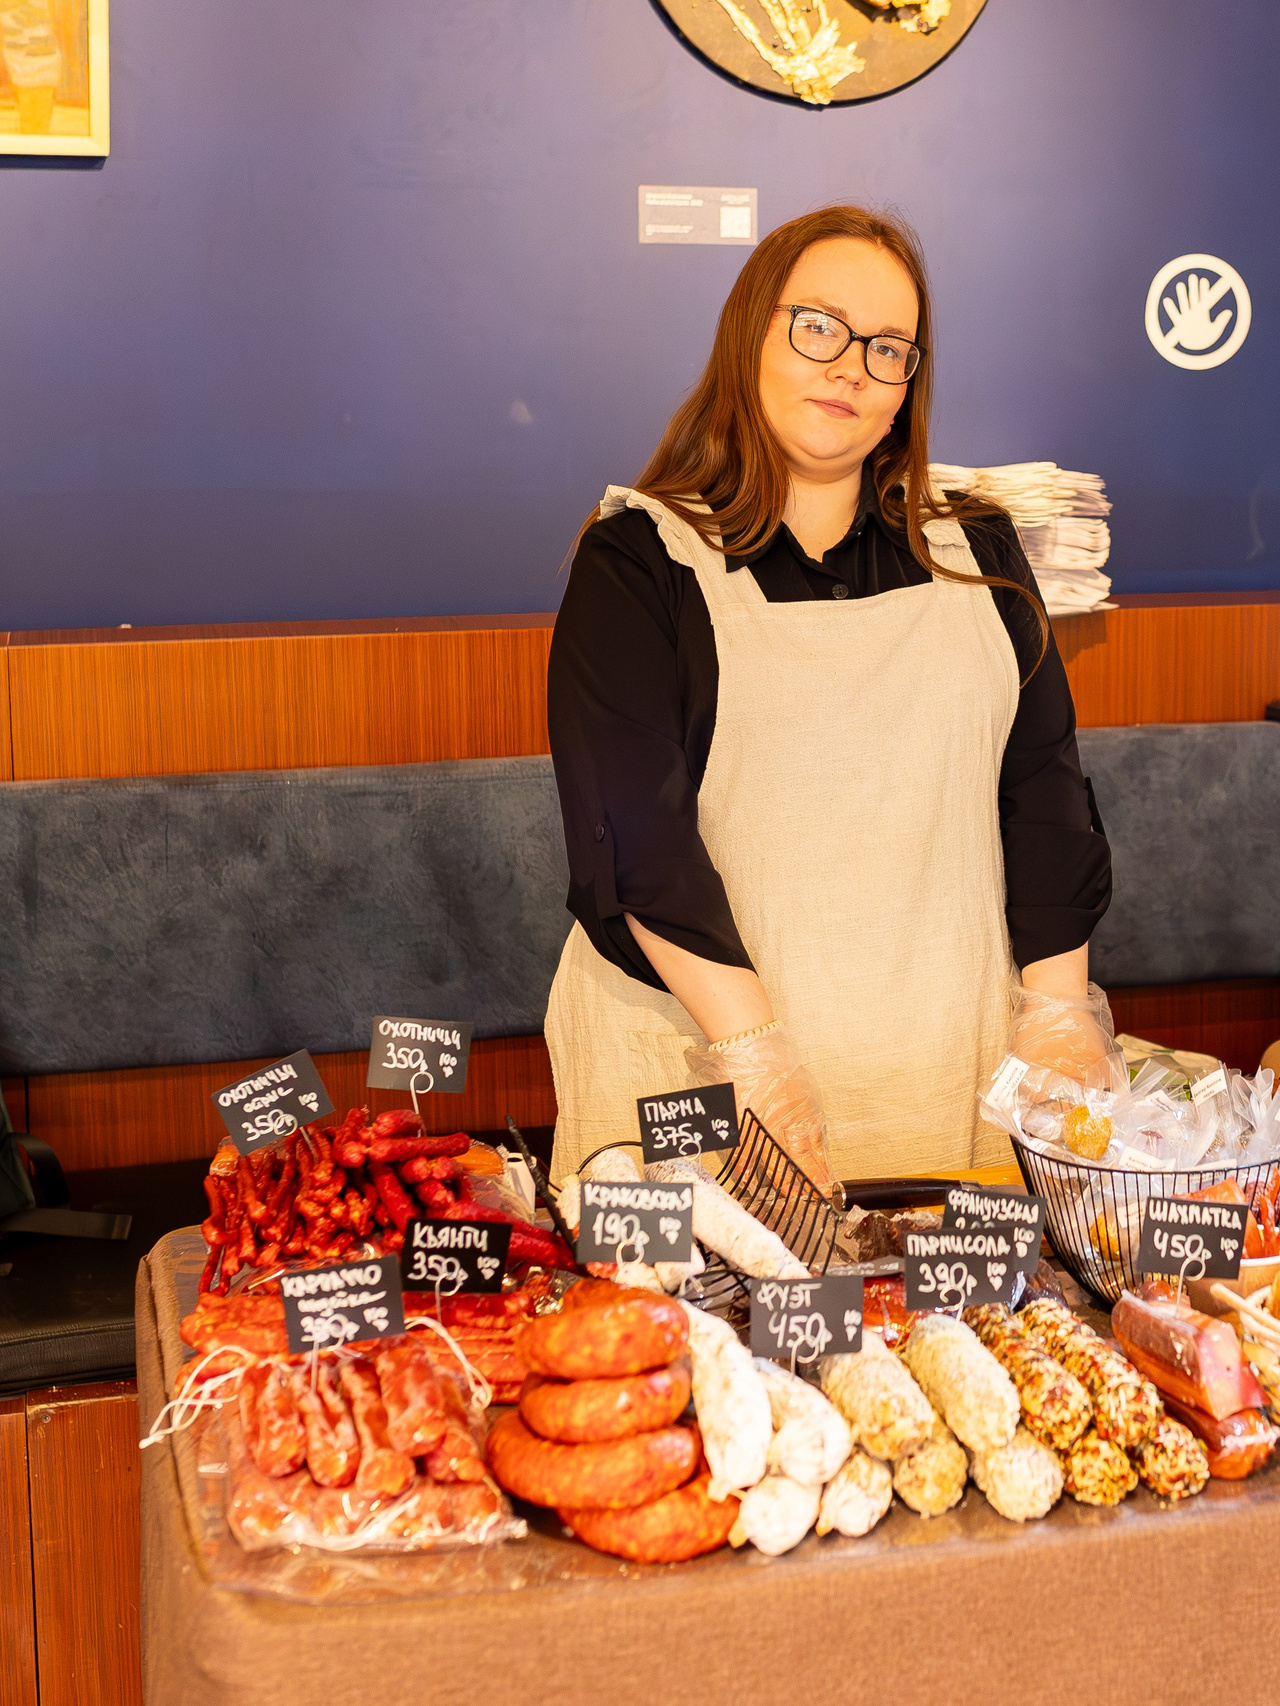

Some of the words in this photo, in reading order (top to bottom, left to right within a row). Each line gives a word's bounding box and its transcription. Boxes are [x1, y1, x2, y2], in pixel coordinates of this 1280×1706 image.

[378, 1020, 461, 1050] ОХОТНИЧЬИ
[439, 1052, 457, 1067] 100
[644, 1097, 706, 1122] ПАРМА
[711, 1119, 729, 1131] 100
[1149, 1199, 1242, 1230] ШАХМАТКА
[412, 1222, 488, 1252] КЬЯНТИ
[1014, 1227, 1035, 1243] 100
[1220, 1237, 1239, 1251] 100
[907, 1235, 1011, 1257] ПАРМИСОЛА
[477, 1256, 500, 1270] 100
[987, 1261, 1007, 1277] 100
[757, 1282, 822, 1311] ФУЭТ
